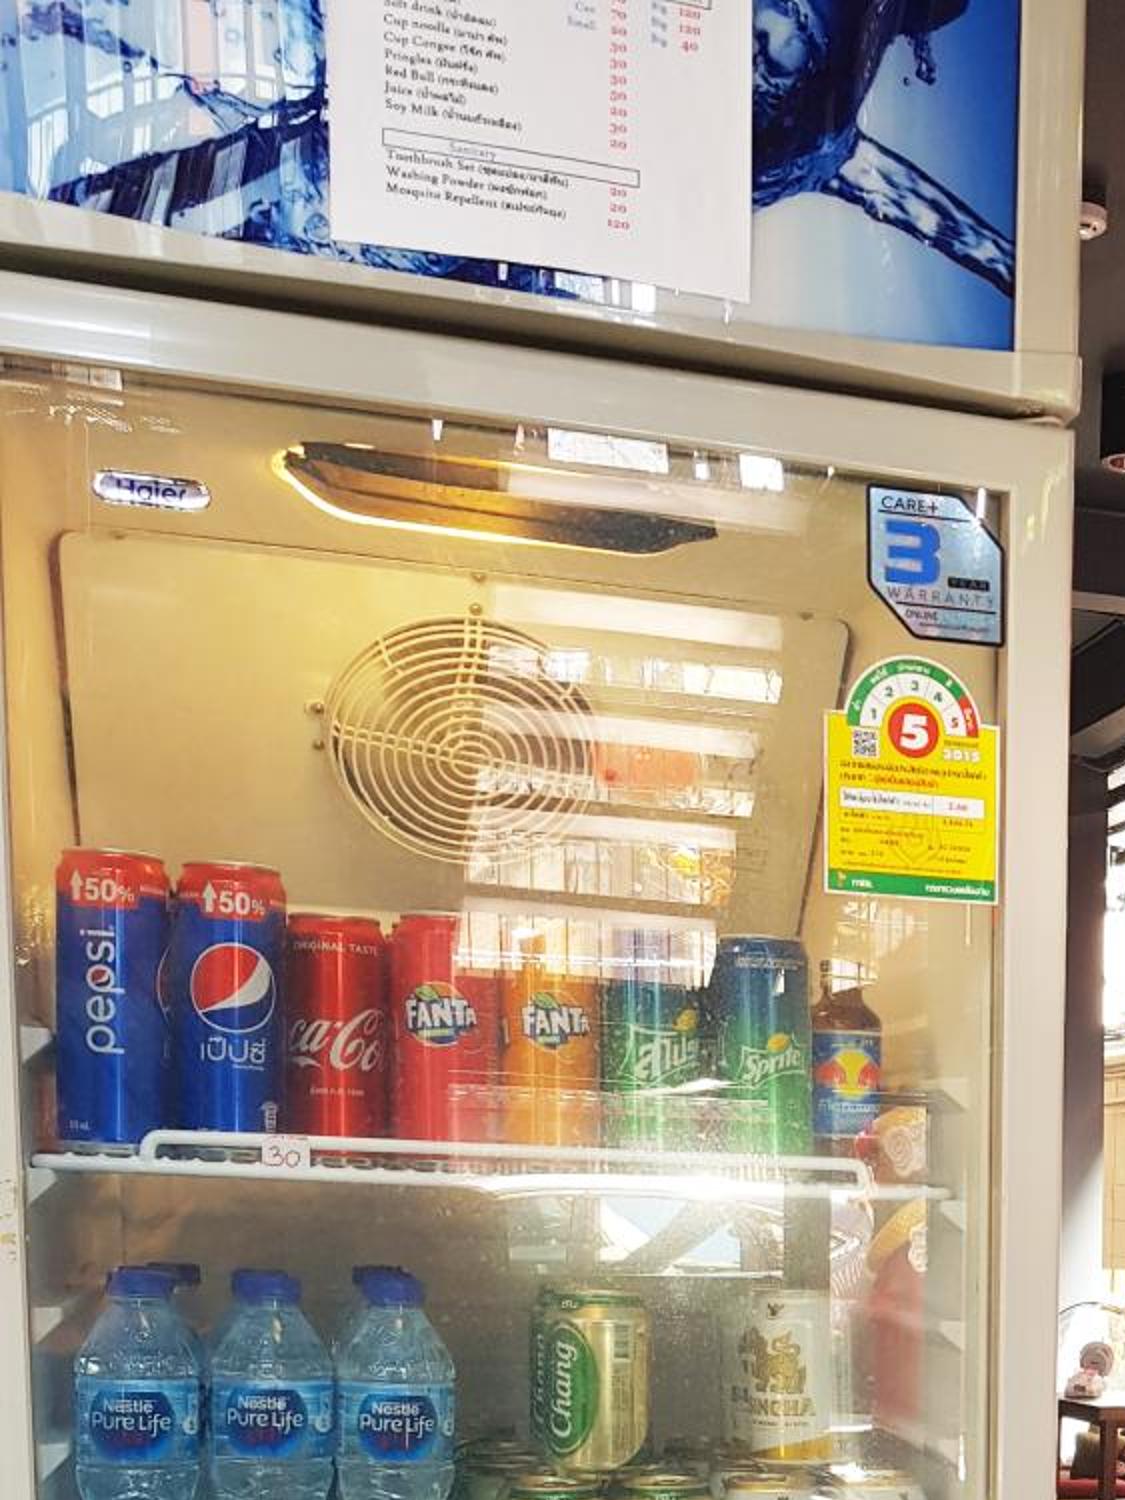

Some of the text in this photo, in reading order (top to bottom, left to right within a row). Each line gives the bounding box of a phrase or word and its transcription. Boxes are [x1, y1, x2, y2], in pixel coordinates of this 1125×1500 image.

[383, 13, 408, 30] Cup
[383, 31, 408, 47] Cup
[384, 47, 431, 65] Pringles
[385, 63, 407, 79] Red
[411, 69, 434, 83] Bull
[384, 80, 412, 95] Juice
[385, 98, 407, 114] Soy
[411, 103, 438, 117] Milk
[387, 150, 454, 169] Toothbrush
[457, 160, 475, 172] Set
[386, 165, 438, 184] Washing
[442, 174, 484, 191] Powder
[609, 203, 627, 214] 20
[385, 182, 441, 201] Mosquito
[445, 191, 498, 209] Repellent
[607, 219, 630, 230] 120
[116, 479, 186, 500] Haier
[884, 519, 941, 585] 3
[887, 587, 993, 609] WARRANTY
[898, 713, 930, 750] 5
[84, 877, 135, 903] 50%
[218, 891, 266, 917] 50%
[79, 928, 126, 1056] pepsi
[405, 995, 478, 1029] FANTA
[521, 1005, 591, 1036] FANTA
[263, 1145, 301, 1168] 30
[550, 1341, 578, 1438] Chang
[91, 1411, 172, 1437] Pure Life
[226, 1408, 304, 1435] Pure Life
[359, 1413, 435, 1438] Pure Life
